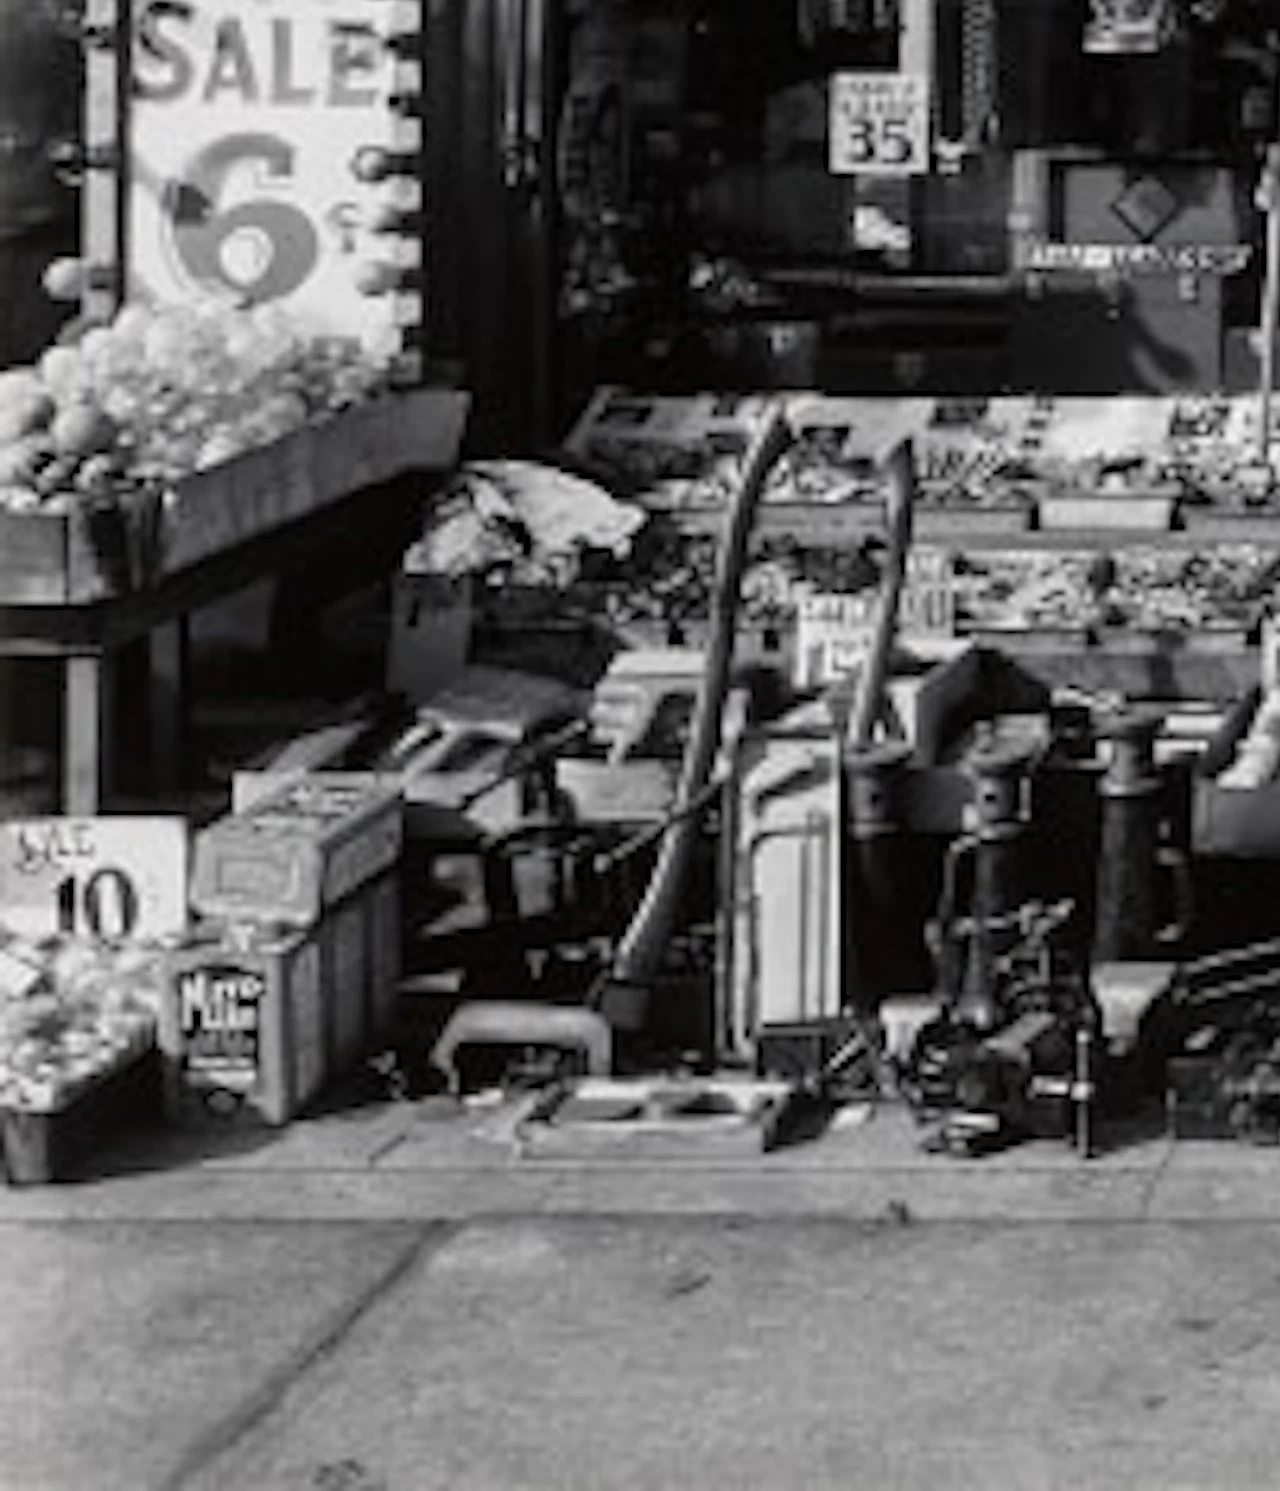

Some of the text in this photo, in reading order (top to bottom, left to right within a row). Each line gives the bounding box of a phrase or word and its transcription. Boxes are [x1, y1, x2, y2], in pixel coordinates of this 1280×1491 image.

[131, 1, 382, 110] SALE
[851, 118, 913, 164] 35
[56, 866, 140, 938] 10
